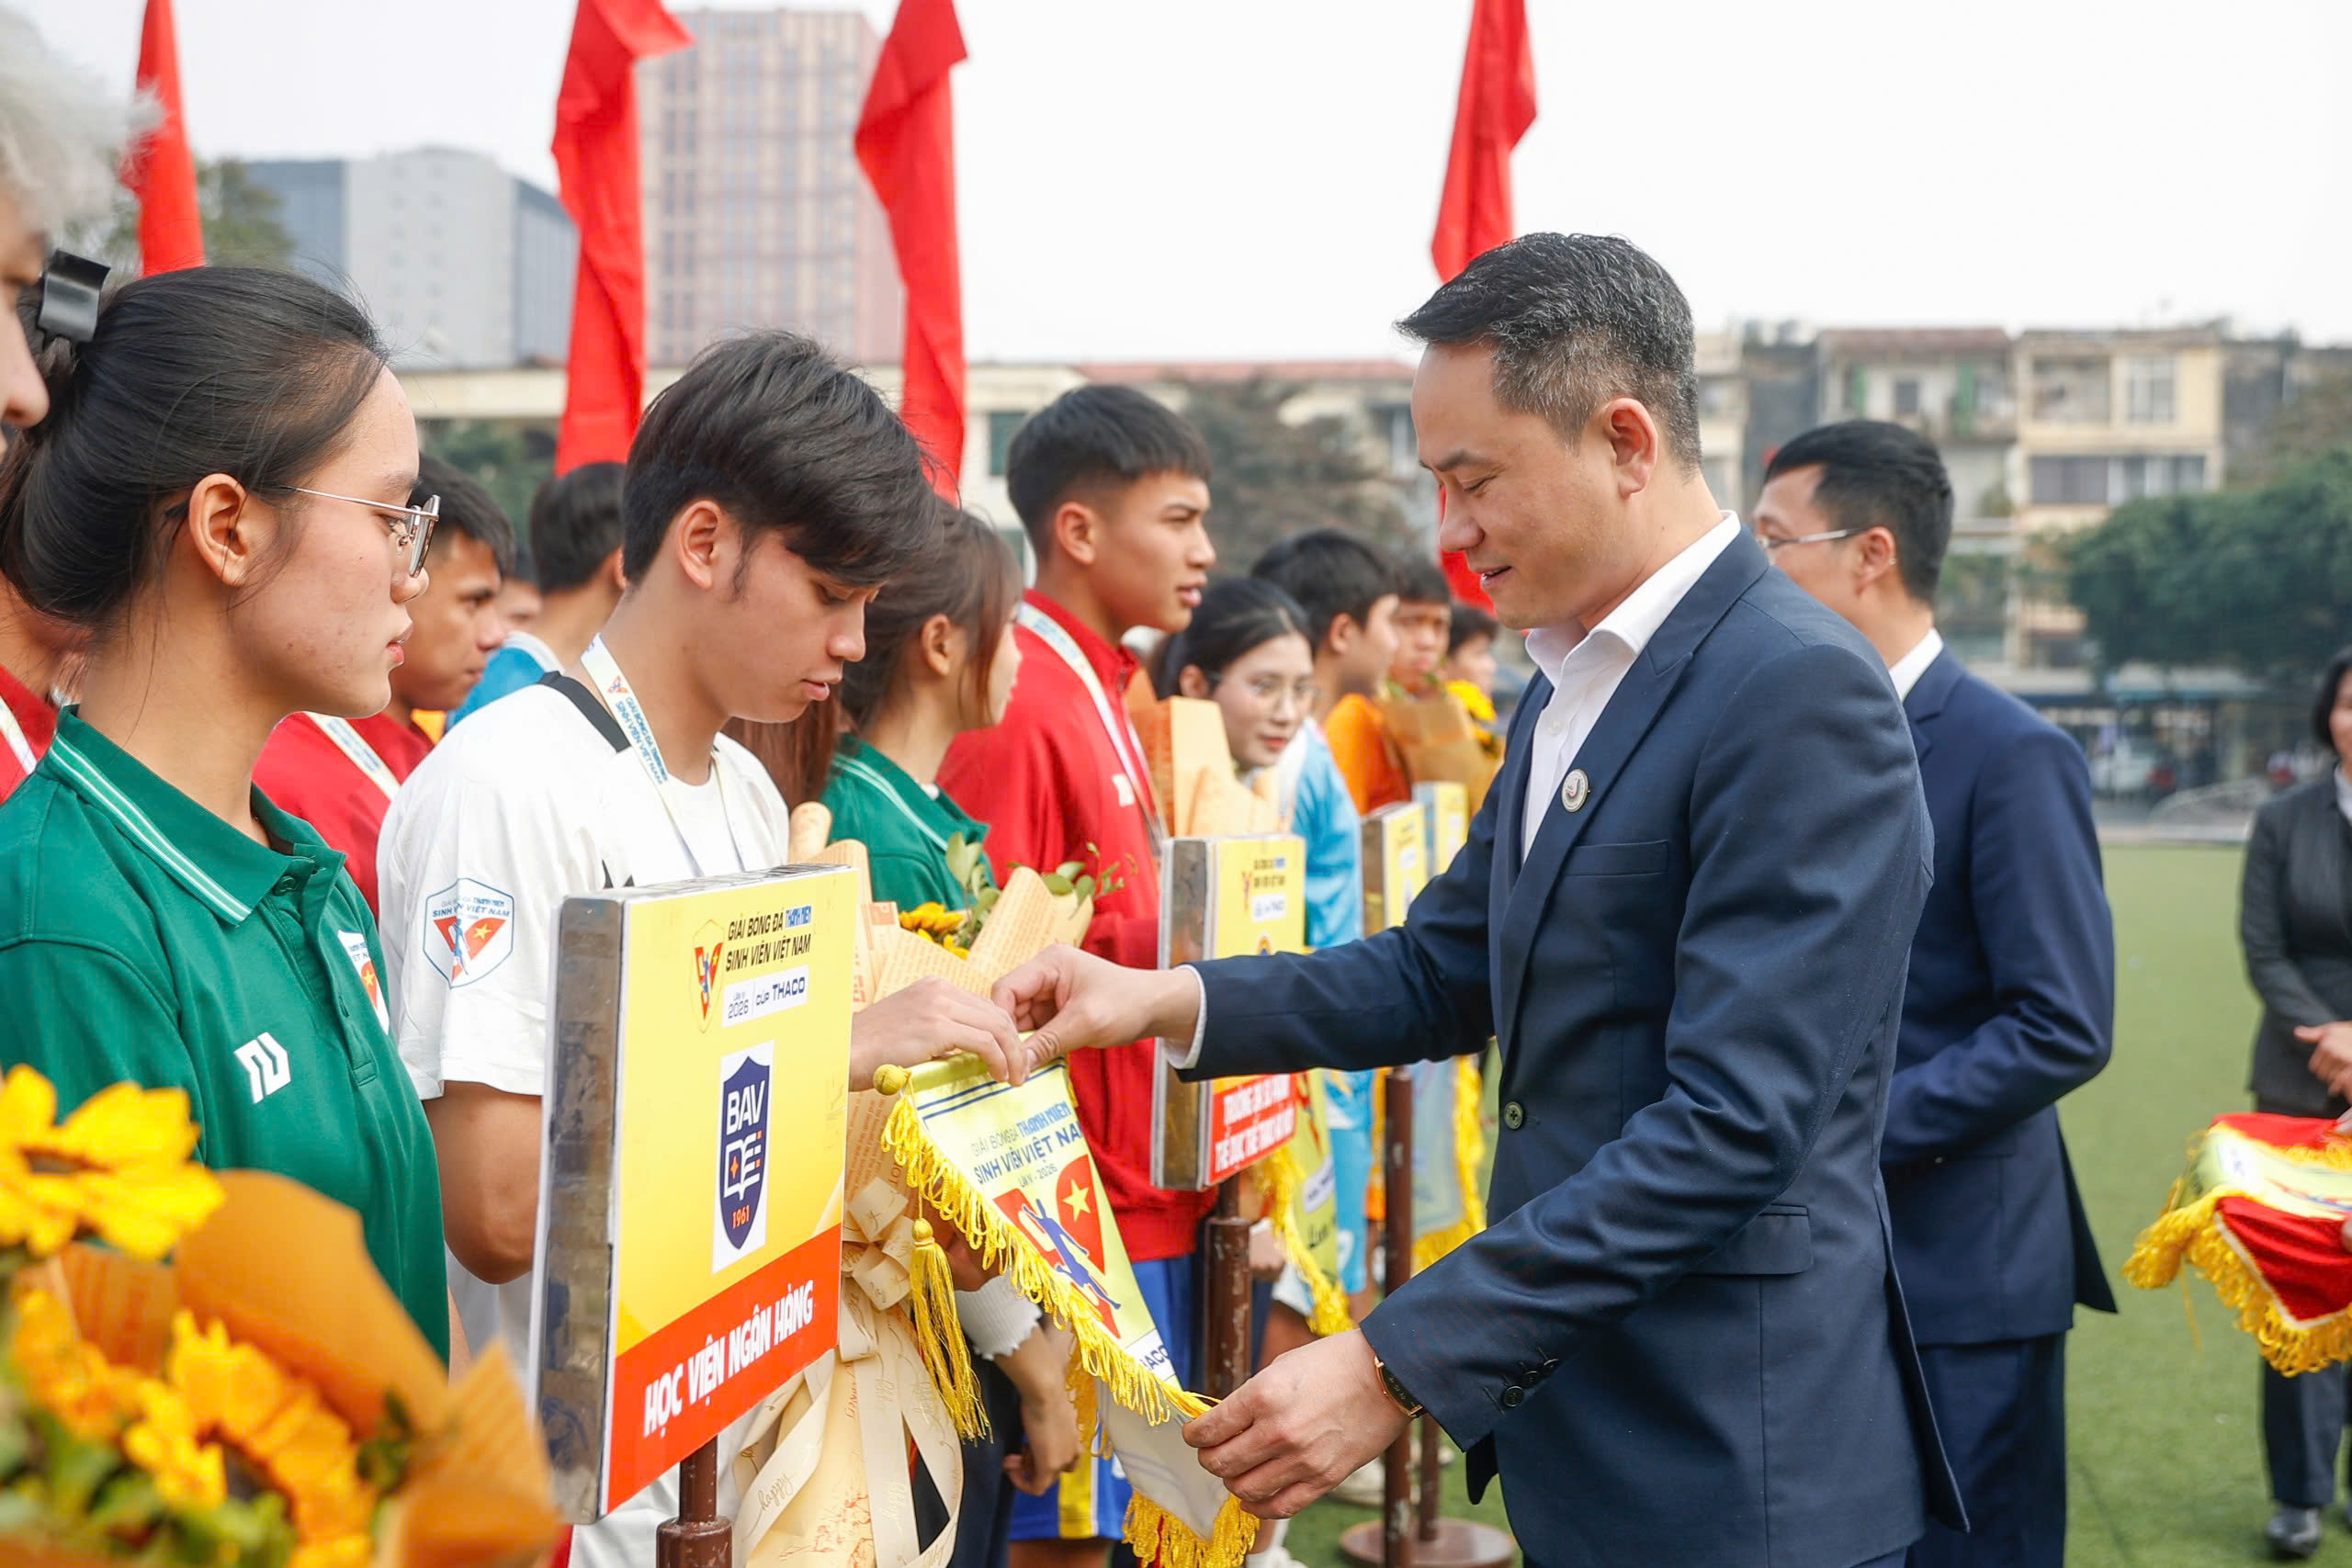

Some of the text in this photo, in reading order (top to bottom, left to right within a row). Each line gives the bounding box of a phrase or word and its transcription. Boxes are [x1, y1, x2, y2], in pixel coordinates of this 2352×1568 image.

[747, 910, 771, 937] BÓNG
[726, 947, 749, 972] SINH
[773, 935, 791, 963] VIỆT
[791, 933, 811, 956] NAM
[773, 976, 806, 1001] THACO
[728, 999, 749, 1020] 2026
[726, 1079, 766, 1135] BAV
[974, 1157, 1002, 1184] SINH
[1021, 1135, 1053, 1164] VIỆT
[731, 1204, 750, 1230] 1961
[643, 1279, 814, 1438] HỌC VIỆN NGÂN HÀNG
